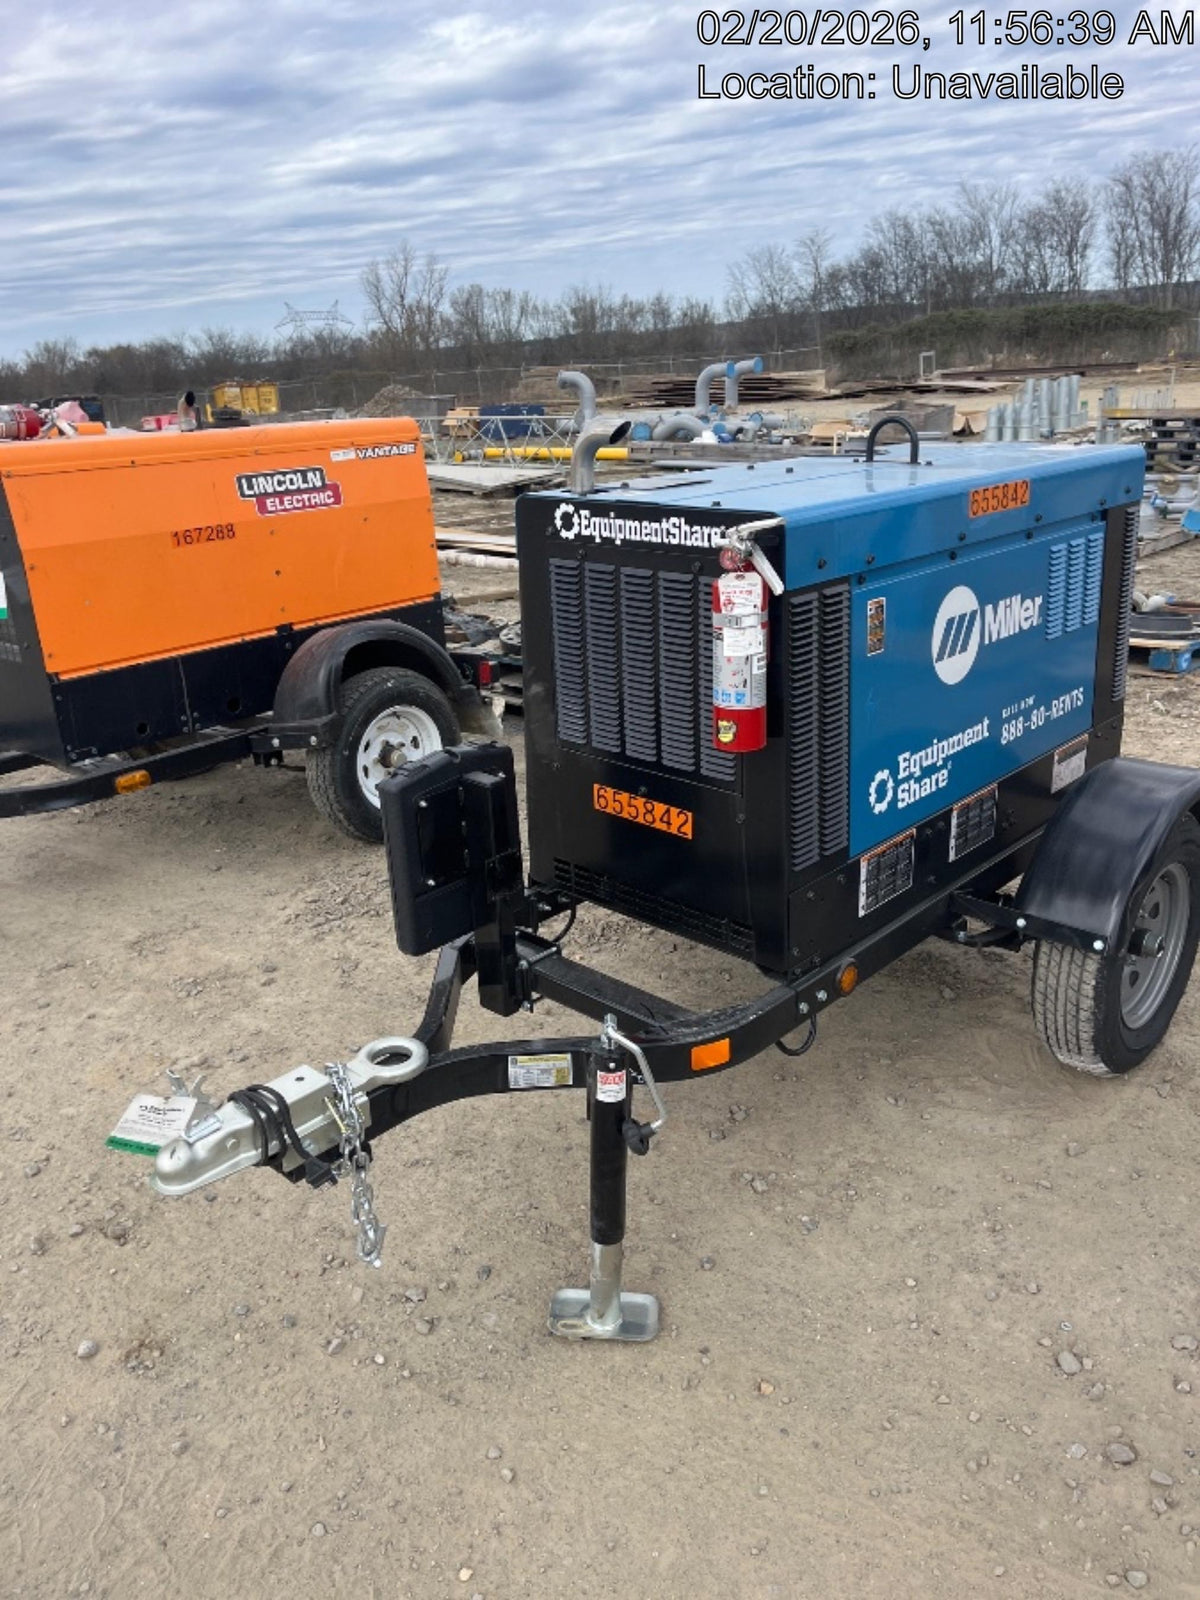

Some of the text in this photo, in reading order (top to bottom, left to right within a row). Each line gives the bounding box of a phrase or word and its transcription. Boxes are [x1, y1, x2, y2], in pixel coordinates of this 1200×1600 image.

[356, 443, 416, 459] VANTAGE
[240, 470, 323, 496] LINCOLN
[265, 490, 335, 512] ELECTRIC
[970, 479, 1030, 517] 655842
[172, 523, 236, 547] 167288
[579, 509, 719, 549] EquipmentShare
[984, 592, 1043, 645] Miller
[1000, 686, 1084, 746] 888-80-RENTS
[897, 716, 990, 779] Equipment
[897, 768, 949, 809] Share
[596, 786, 690, 836] 655842
